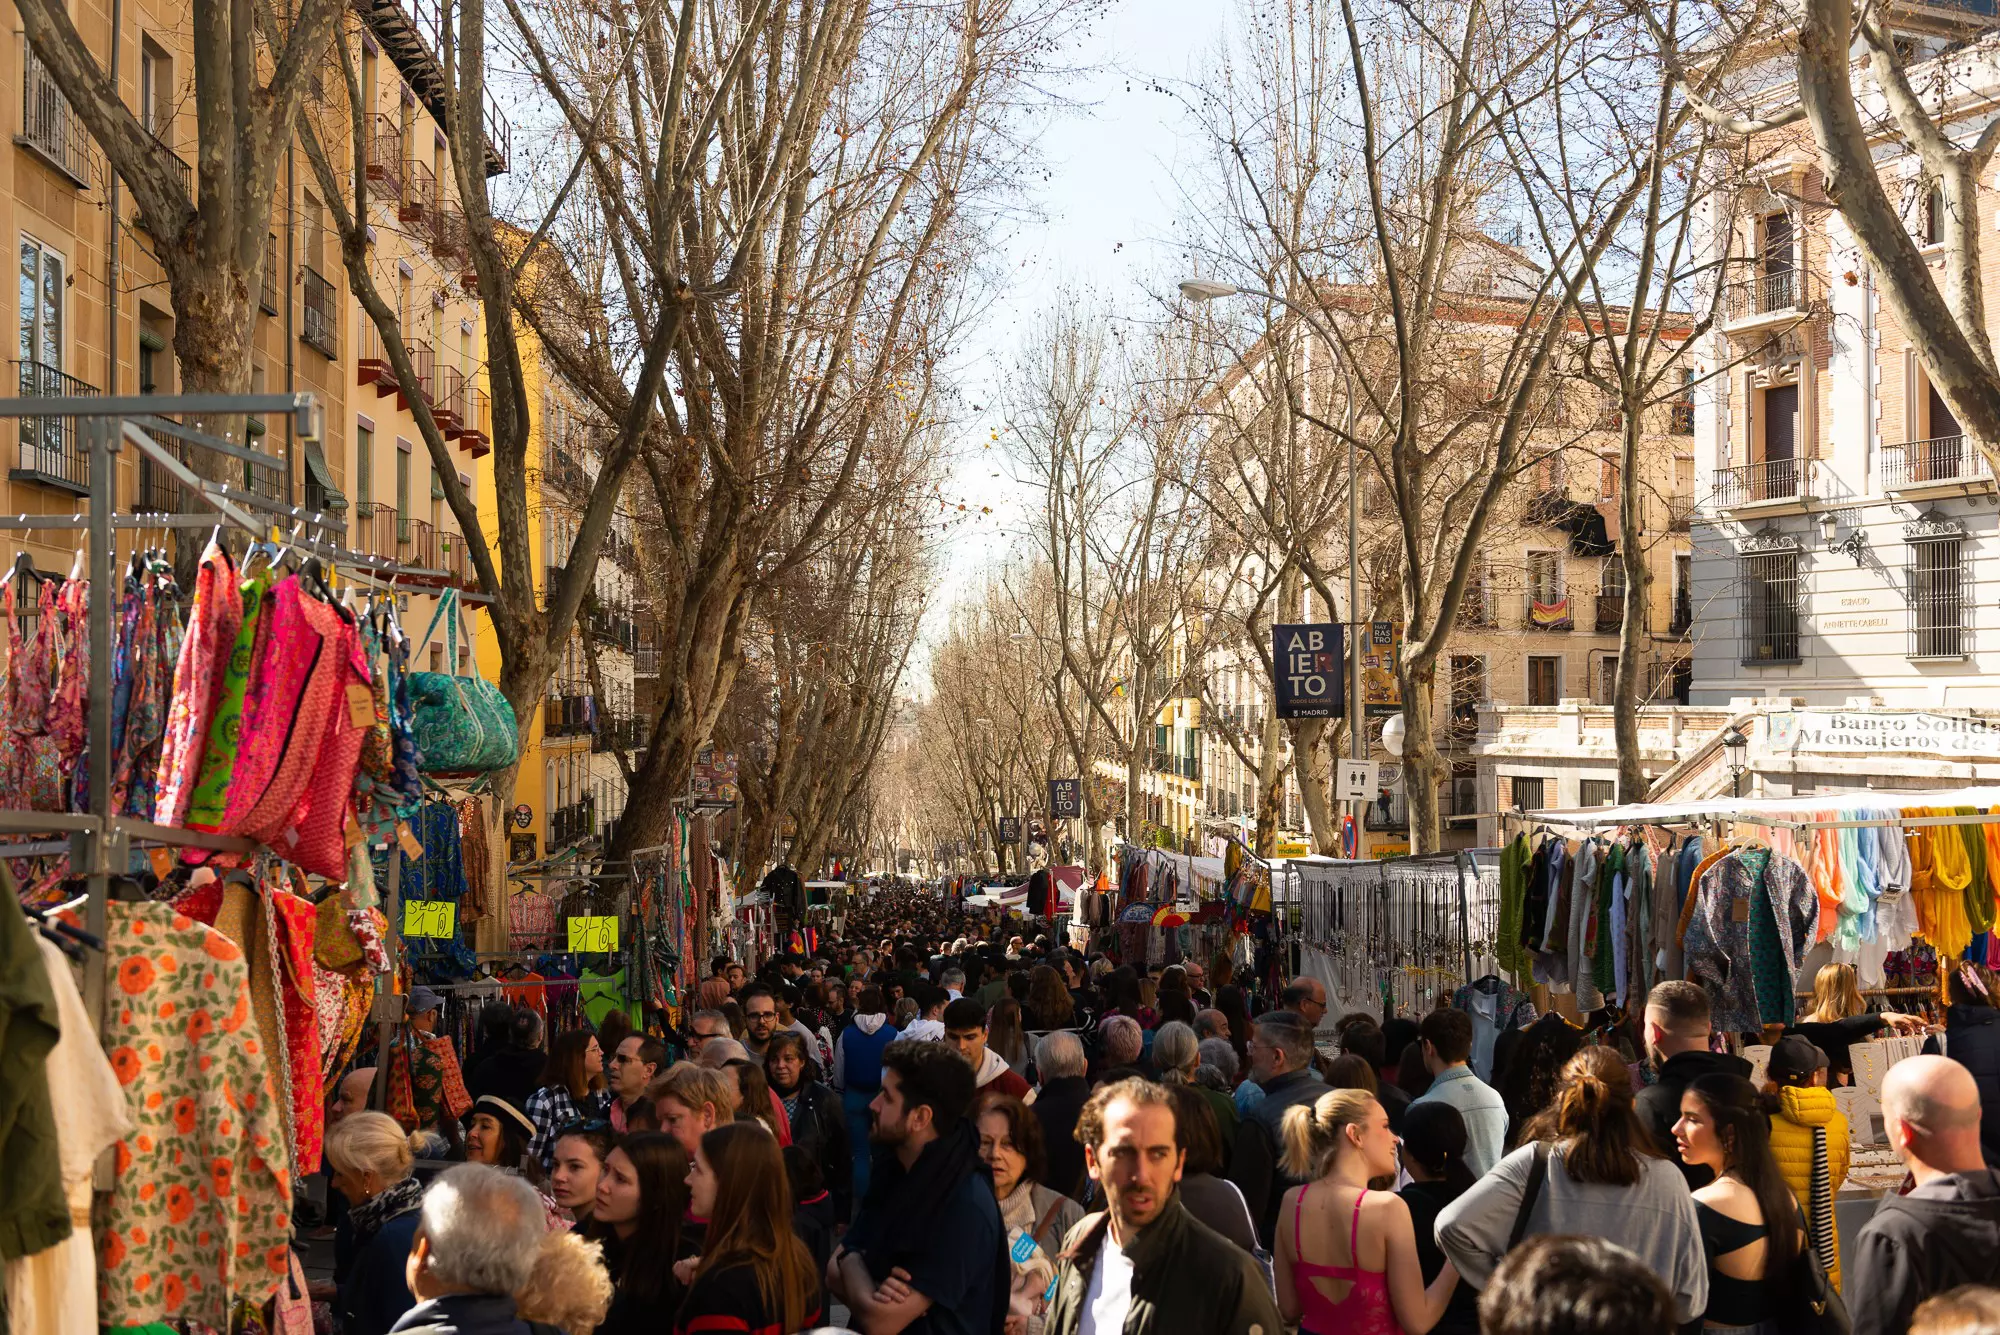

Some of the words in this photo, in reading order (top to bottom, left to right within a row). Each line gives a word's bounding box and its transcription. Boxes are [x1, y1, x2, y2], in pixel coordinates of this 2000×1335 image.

[1841, 597, 1870, 606] ESPACIO
[1823, 619, 1858, 629] ANNETTE
[1858, 618, 1889, 628] CABELLI
[1288, 631, 1324, 651] AB
[1374, 636, 1391, 644] TRO
[1289, 653, 1335, 673] IER
[1287, 675, 1327, 697] TO
[1831, 714, 1907, 731] Banco
[1800, 729, 1940, 750] Mensajeros
[1952, 735, 1987, 751] de
[1056, 782, 1072, 791] AB
[1056, 801, 1073, 810] TO
[407, 900, 449, 914] SEDA
[573, 916, 612, 934] SILK
